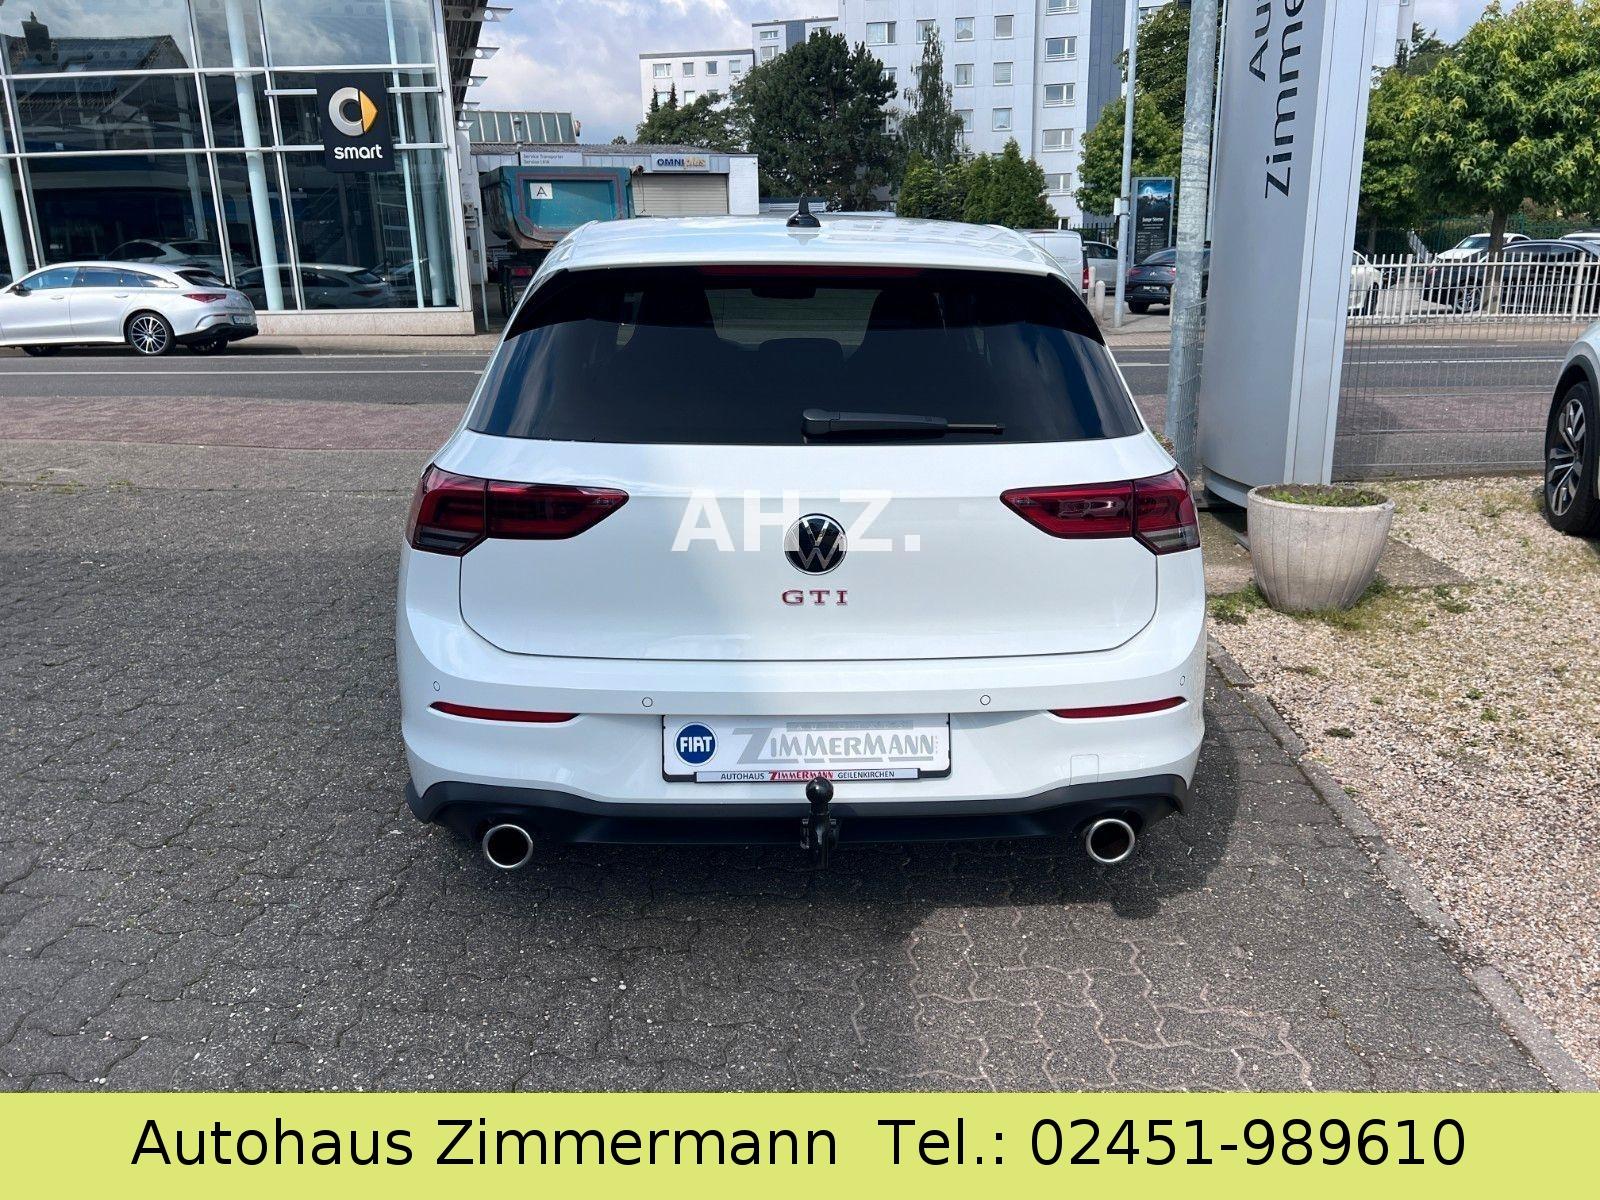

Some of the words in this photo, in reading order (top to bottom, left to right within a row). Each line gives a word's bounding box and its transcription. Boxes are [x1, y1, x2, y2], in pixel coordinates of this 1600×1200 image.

[1249, 0, 1271, 82] Au
[333, 143, 384, 160] smart
[536, 185, 548, 197] A
[781, 589, 848, 606] GTI
[680, 736, 713, 753] FIAT
[732, 727, 934, 765] ZIMMERMANN
[720, 772, 765, 780] AUTOHAUS
[768, 770, 834, 781] ZIMMERMANN
[837, 770, 895, 779] GEILENKIRCHEN
